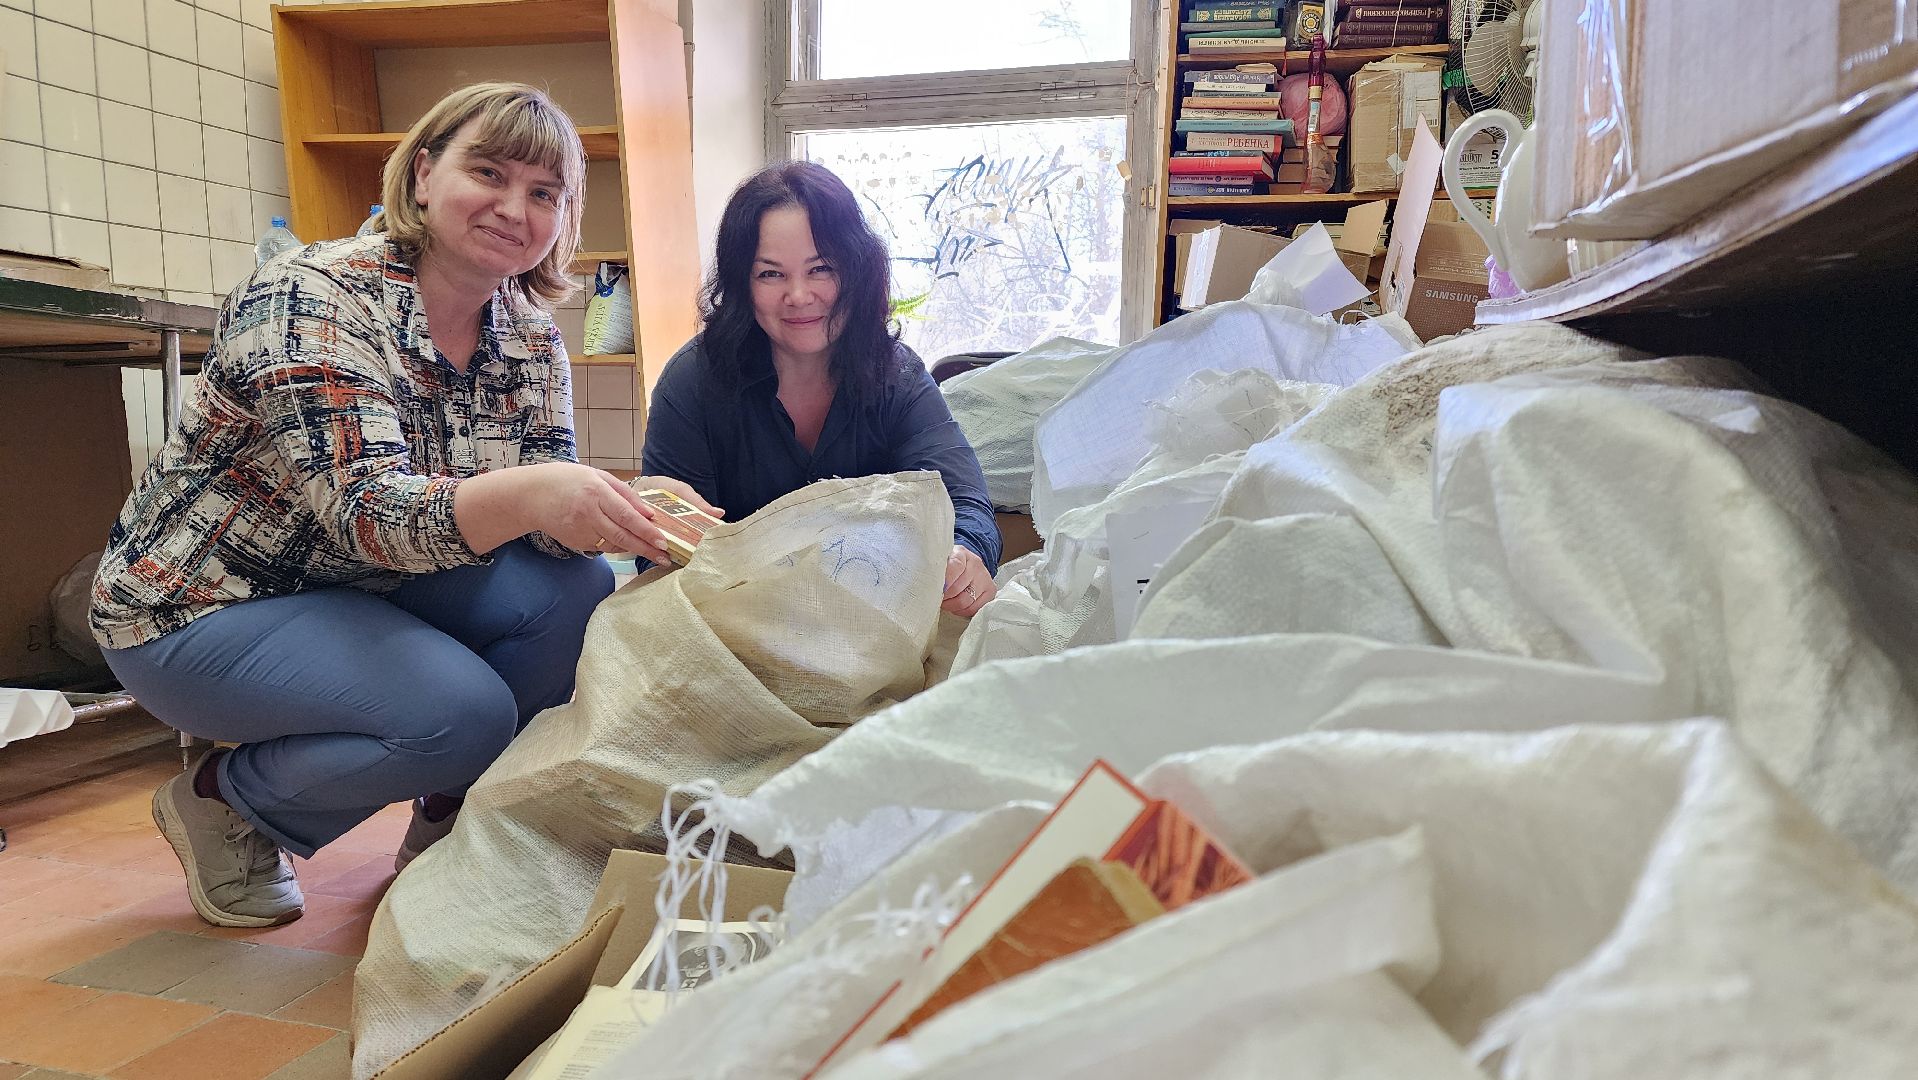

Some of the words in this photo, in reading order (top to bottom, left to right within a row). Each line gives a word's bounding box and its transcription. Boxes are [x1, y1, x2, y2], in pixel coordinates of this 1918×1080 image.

[1227, 138, 1270, 149] РЕБЕНКА
[1491, 149, 1499, 160] 5
[1425, 289, 1479, 304] SAMSUNG
